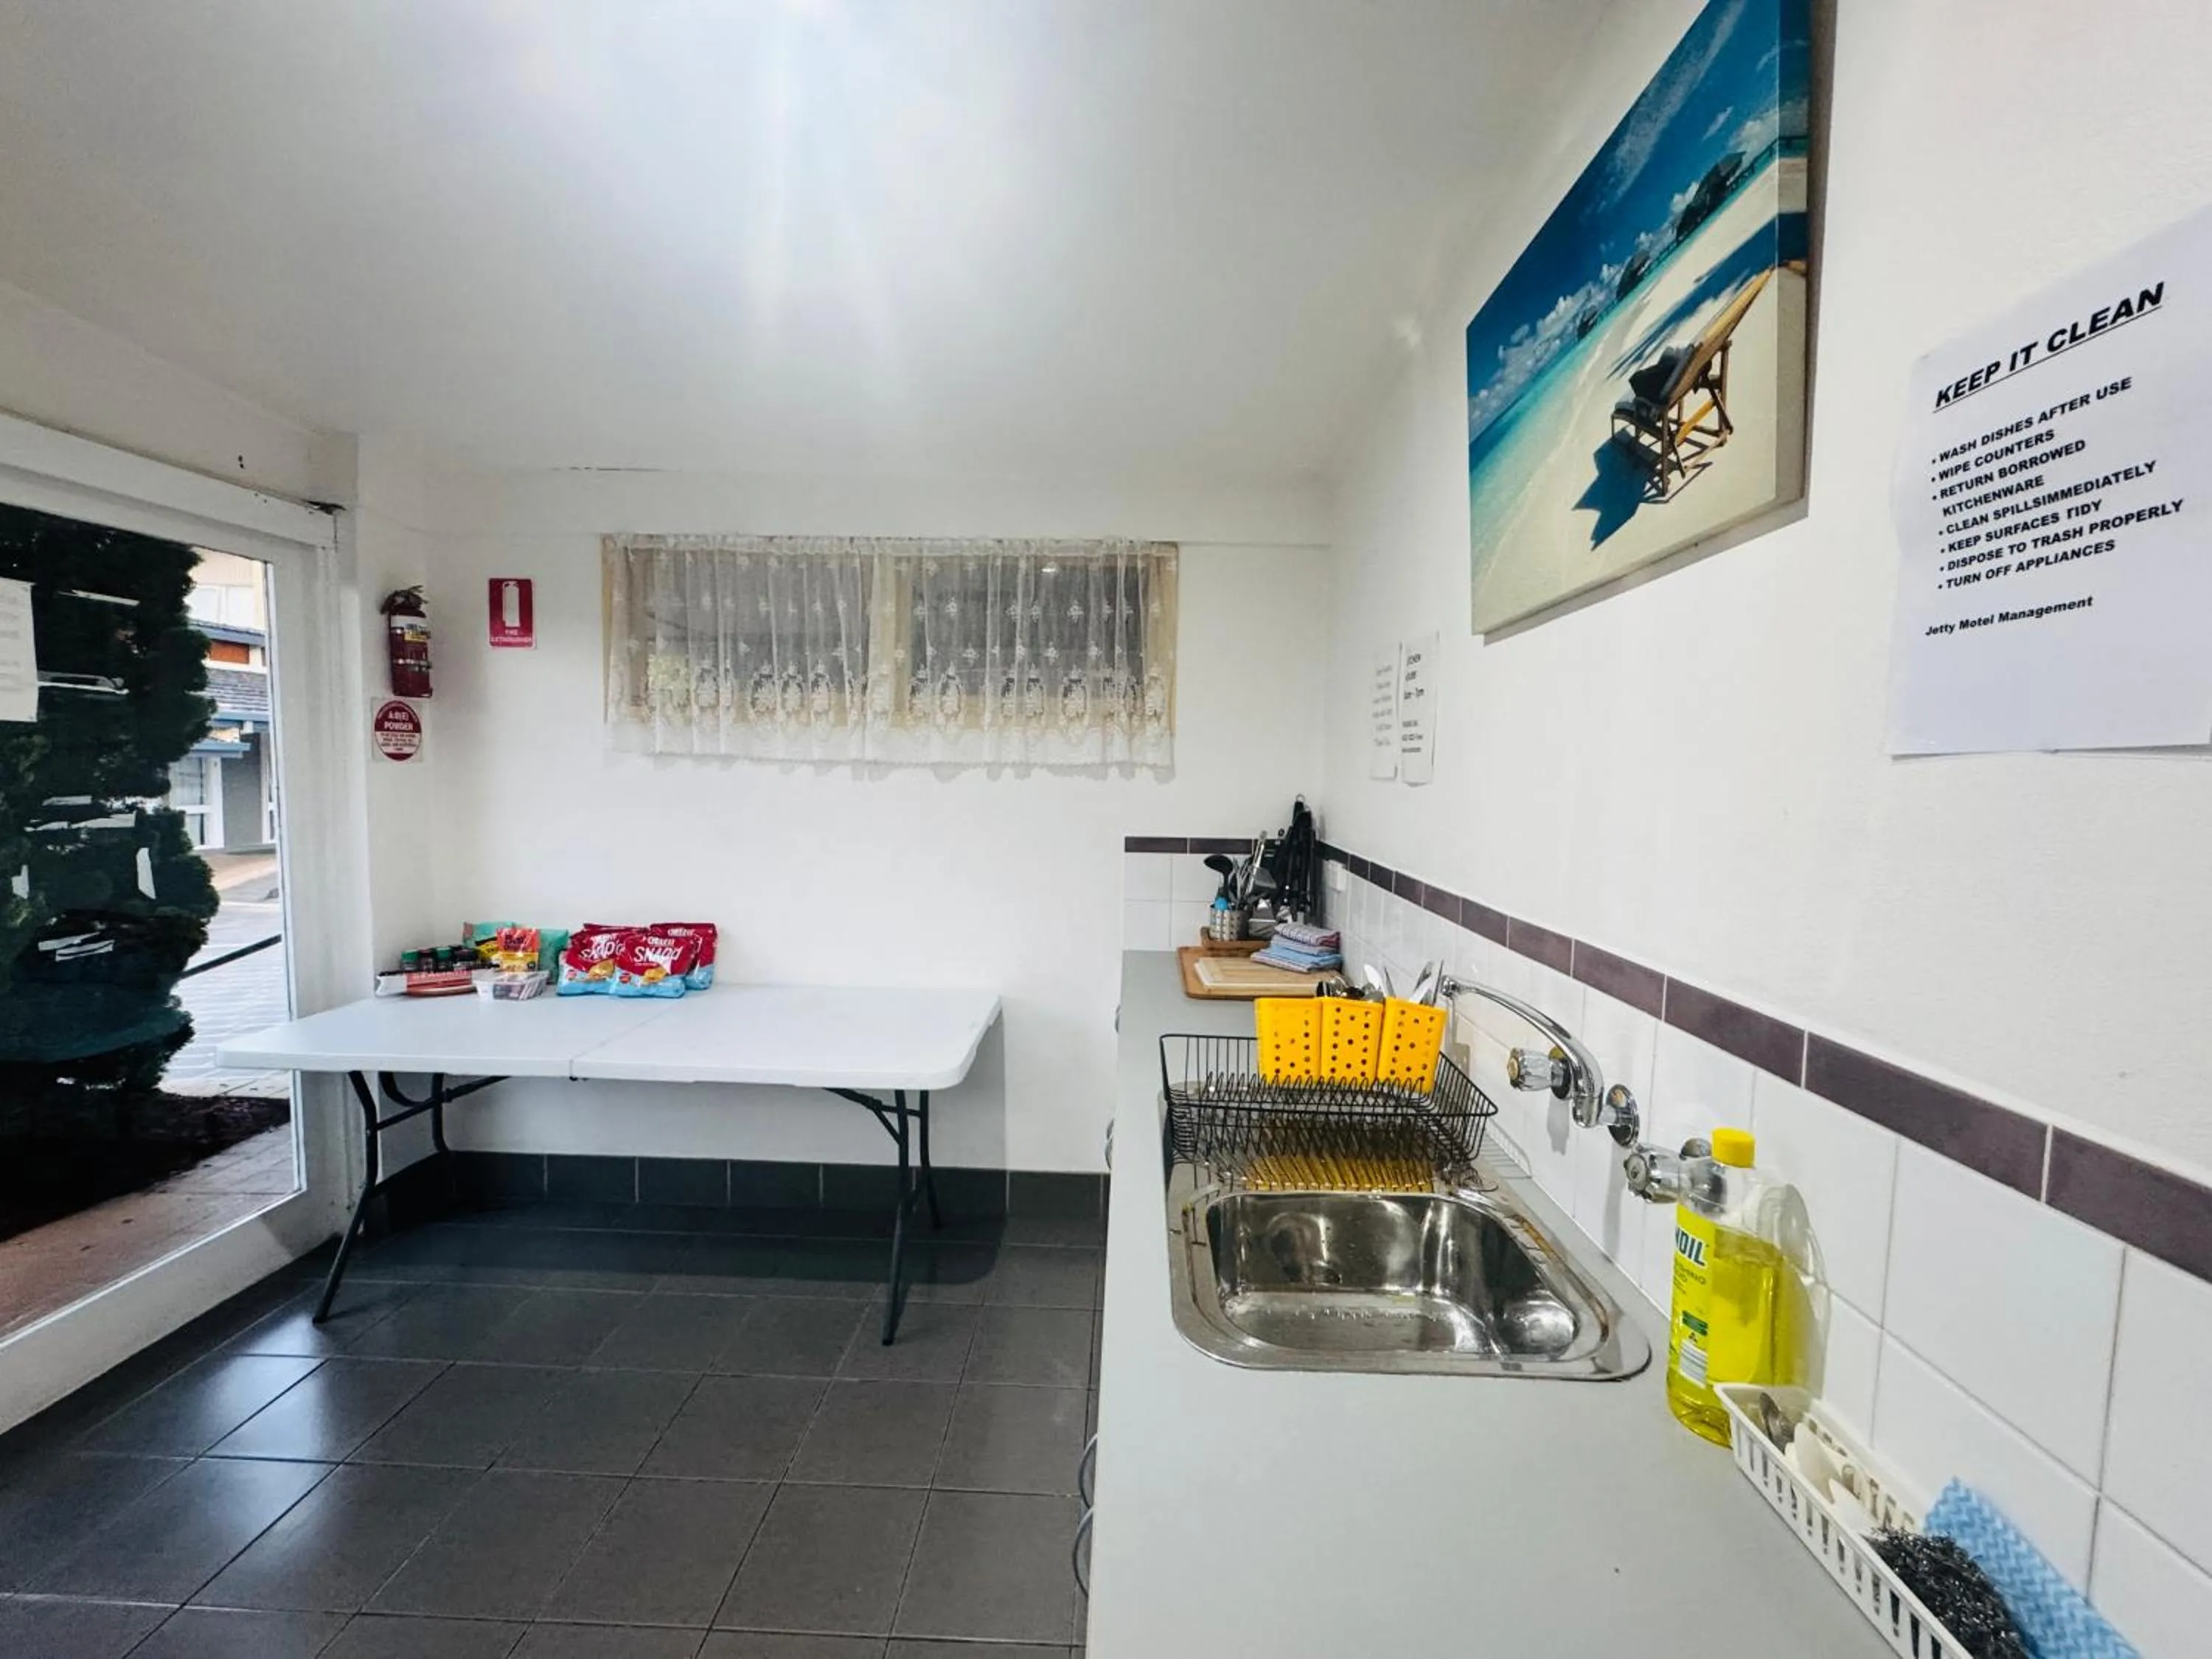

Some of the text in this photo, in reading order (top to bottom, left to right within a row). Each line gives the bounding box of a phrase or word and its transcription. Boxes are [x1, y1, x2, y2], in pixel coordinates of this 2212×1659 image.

[1936, 282, 2164, 408] KEEP IT CLEAN
[1939, 377, 2132, 462] WASH DISHES AFTER USE
[1938, 429, 2054, 479] WIPE COUNTERS
[1939, 440, 2085, 499] RETURN BORROWED
[1942, 475, 2045, 517] KITCHENWARE
[1947, 514, 1989, 534] CLEAN
[1947, 498, 2183, 571] DISPOSE TO TRASH PROPERLY
[1948, 535, 1981, 552] KEEP
[1985, 513, 2059, 541] SURFACES
[1947, 540, 2115, 589] TURN OFF APPLIANCES
[1925, 596, 2093, 636] Jetty Motel Management
